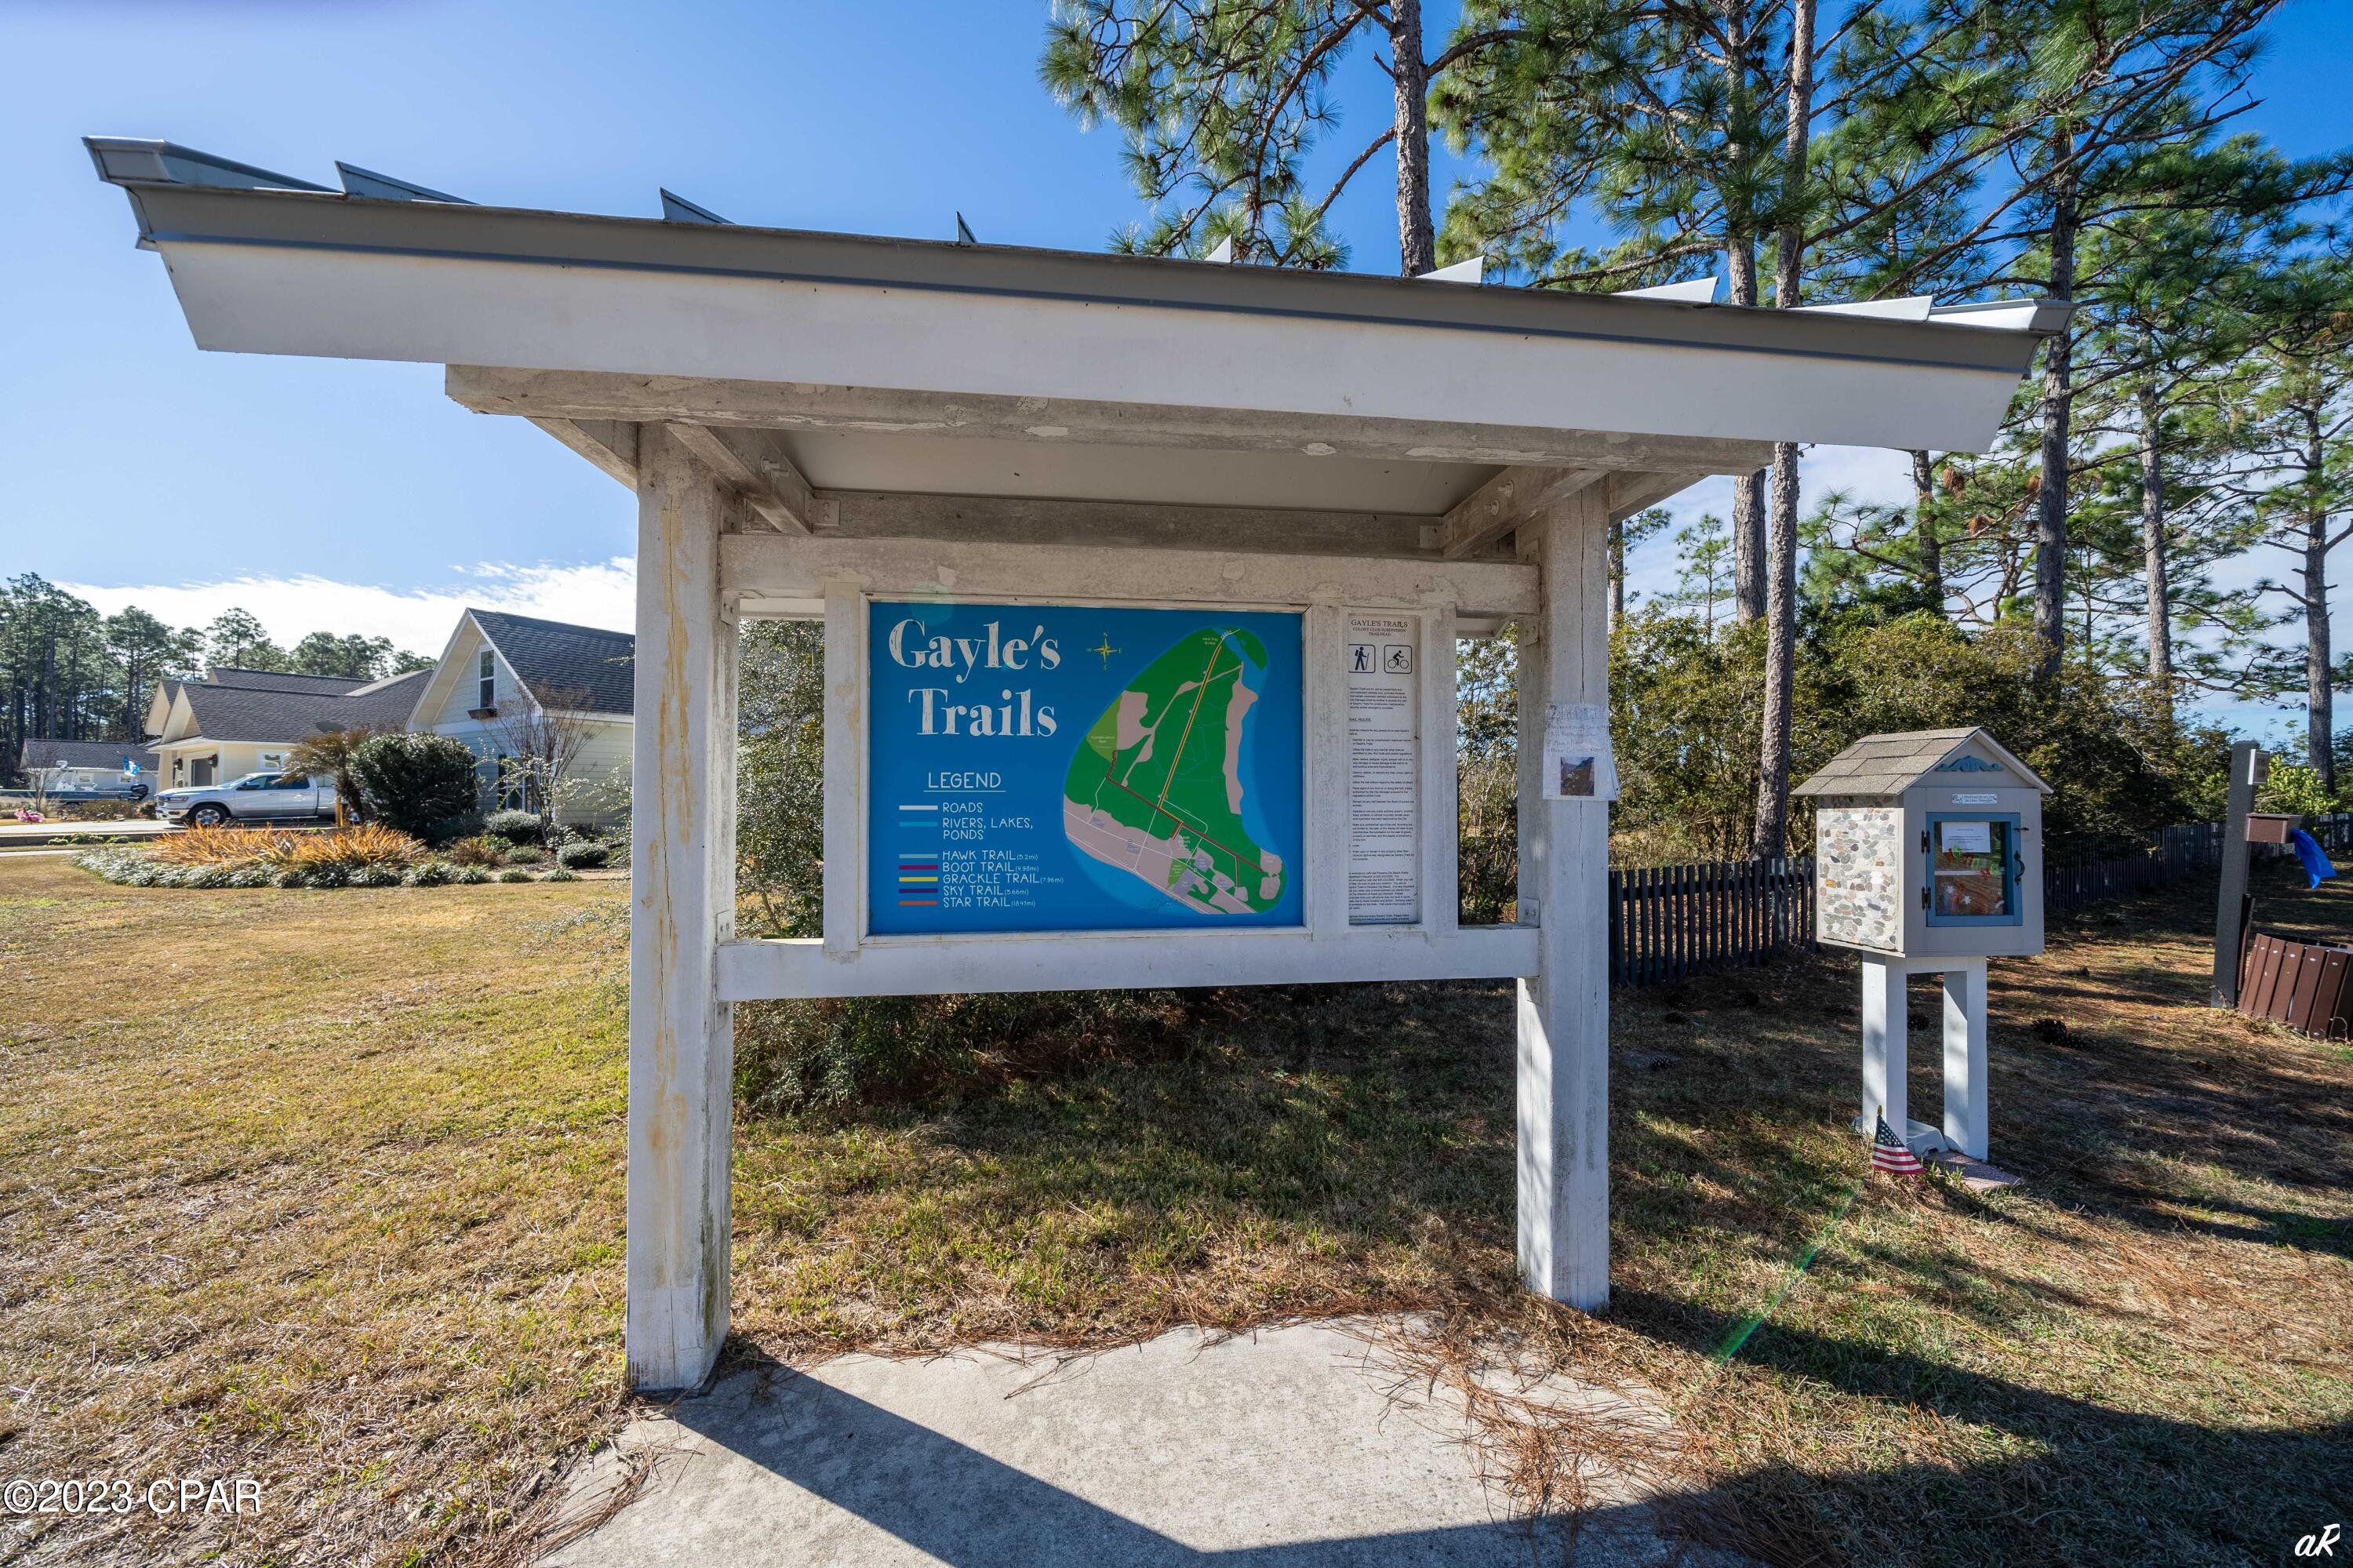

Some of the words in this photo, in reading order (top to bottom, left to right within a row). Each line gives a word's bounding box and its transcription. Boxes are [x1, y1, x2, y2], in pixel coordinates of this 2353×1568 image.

[889, 619, 1061, 683] Gayle's
[908, 688, 1057, 737] Trails
[928, 772, 1002, 788] LEGEND
[943, 802, 983, 813] ROADS
[943, 818, 987, 829] RIVERS,
[991, 817, 1034, 829] LAKES,
[943, 830, 984, 840] PONDS
[943, 850, 977, 860] HAWK
[982, 849, 1016, 860] TRAIL
[943, 862, 975, 872] BOOT
[980, 861, 1014, 872] TRAIL
[943, 874, 1001, 884] GRACKLE
[1006, 872, 1039, 883] TRAIL
[943, 886, 963, 896] SKY
[969, 885, 1004, 895] TRAIL
[943, 897, 972, 908] STAR
[976, 897, 1010, 907] TRAIL
